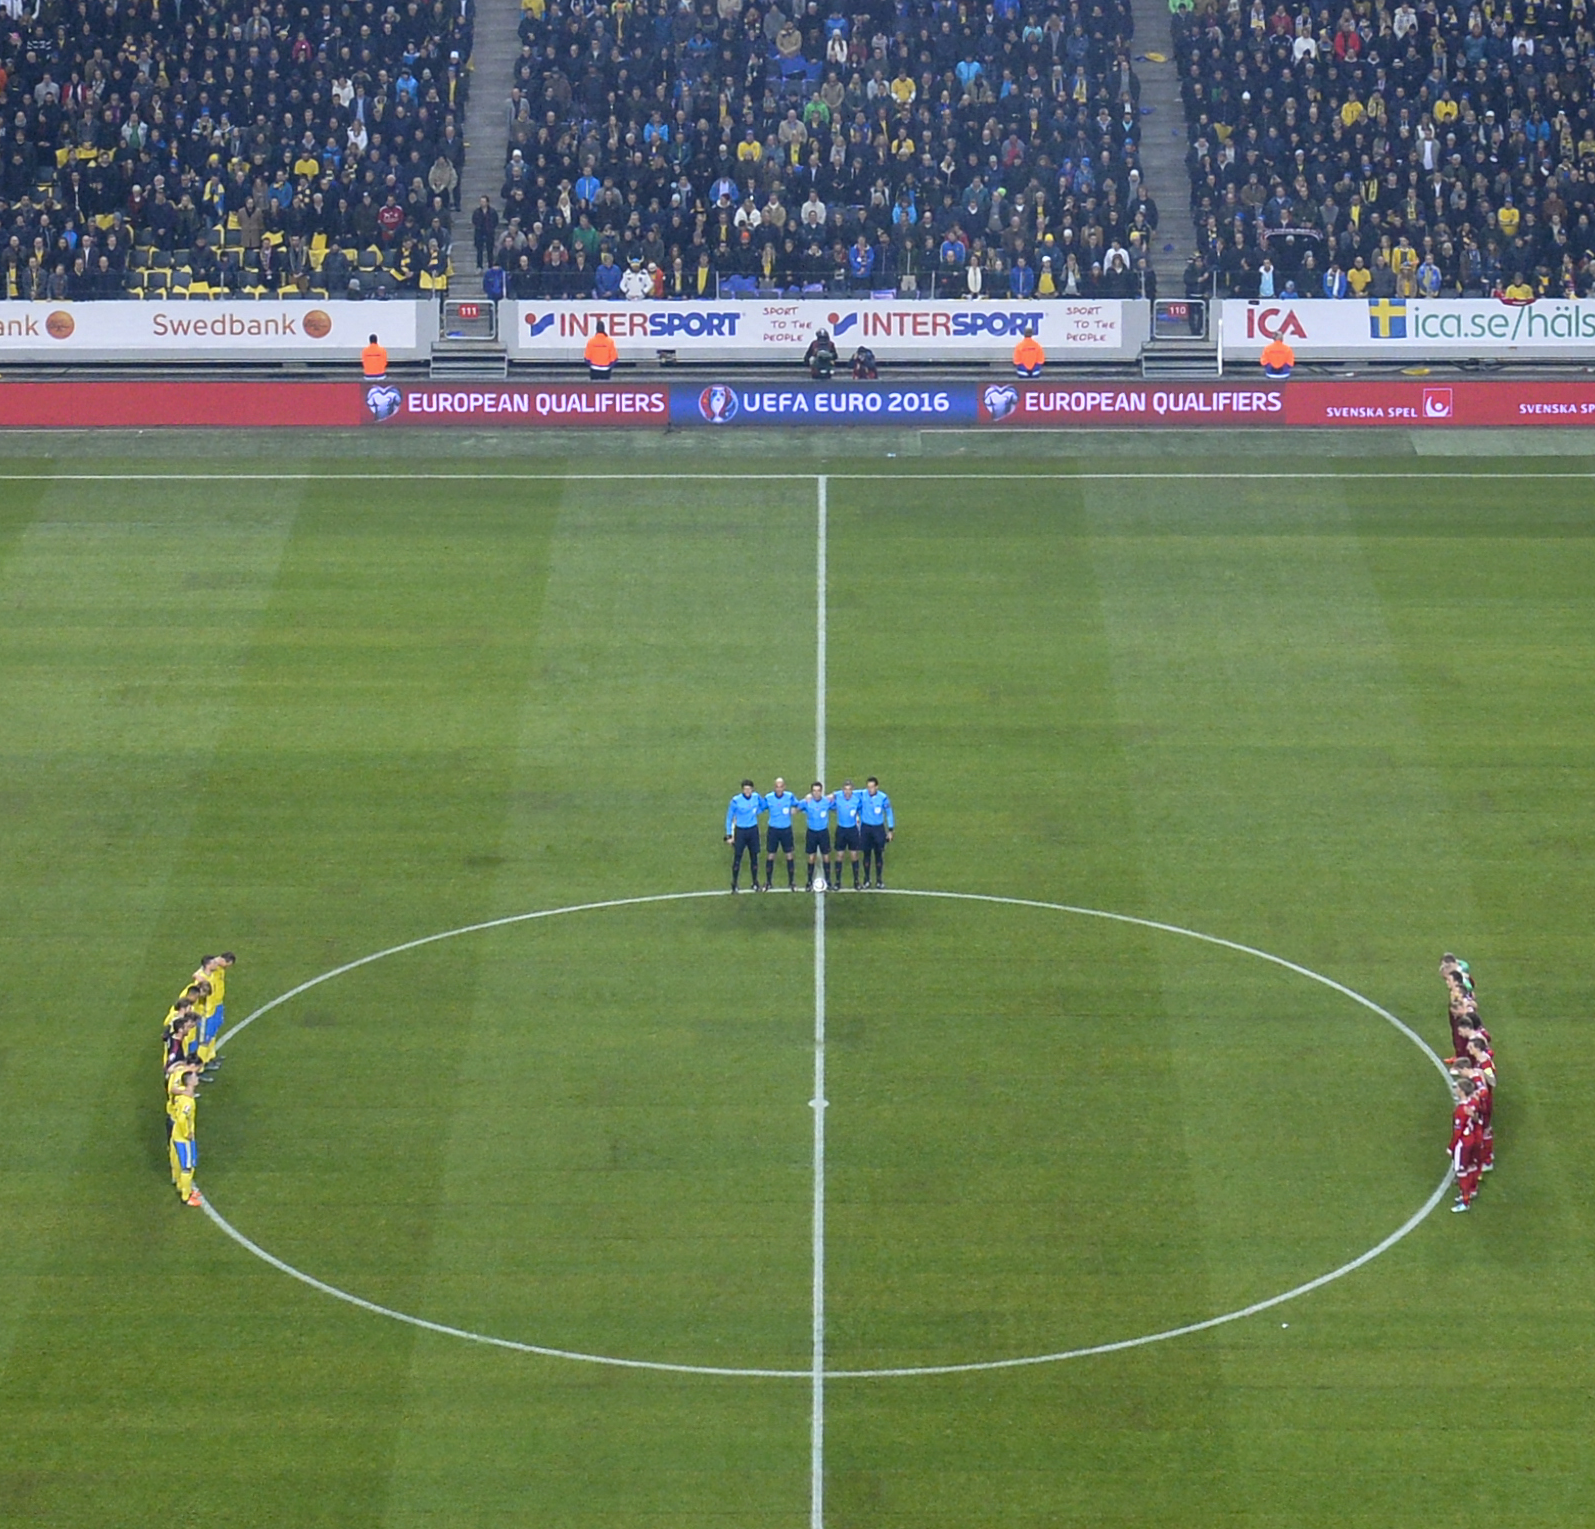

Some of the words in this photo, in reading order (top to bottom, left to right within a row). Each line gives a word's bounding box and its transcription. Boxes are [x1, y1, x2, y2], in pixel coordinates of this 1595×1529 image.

[461, 306, 477, 316] 111
[762, 306, 799, 316] SPORT
[1065, 306, 1102, 315] SPORT
[1170, 306, 1186, 315] 110
[152, 312, 297, 337] Swedbank
[560, 312, 741, 336] INTERSPORT
[771, 320, 788, 329] TO
[791, 320, 813, 329] THE
[863, 311, 1044, 336] INTERSPORT
[1074, 320, 1090, 329] TO
[1094, 320, 1116, 329] THE
[1247, 308, 1308, 339] ICA
[763, 333, 804, 342] PEOPLE
[1066, 332, 1107, 341] PEOPLE
[407, 392, 529, 412] EUROPEAN
[535, 392, 666, 416] QUALIFIERS
[742, 392, 809, 412] UEFA
[814, 392, 882, 412] EURO
[887, 392, 950, 412] 2016
[1024, 391, 1146, 411] EUROPEAN
[1152, 391, 1282, 415] QUALIFIERS
[1325, 406, 1384, 418] SVENSKA
[1387, 406, 1418, 418] SPEL
[1518, 403, 1578, 414] SVENSKA
